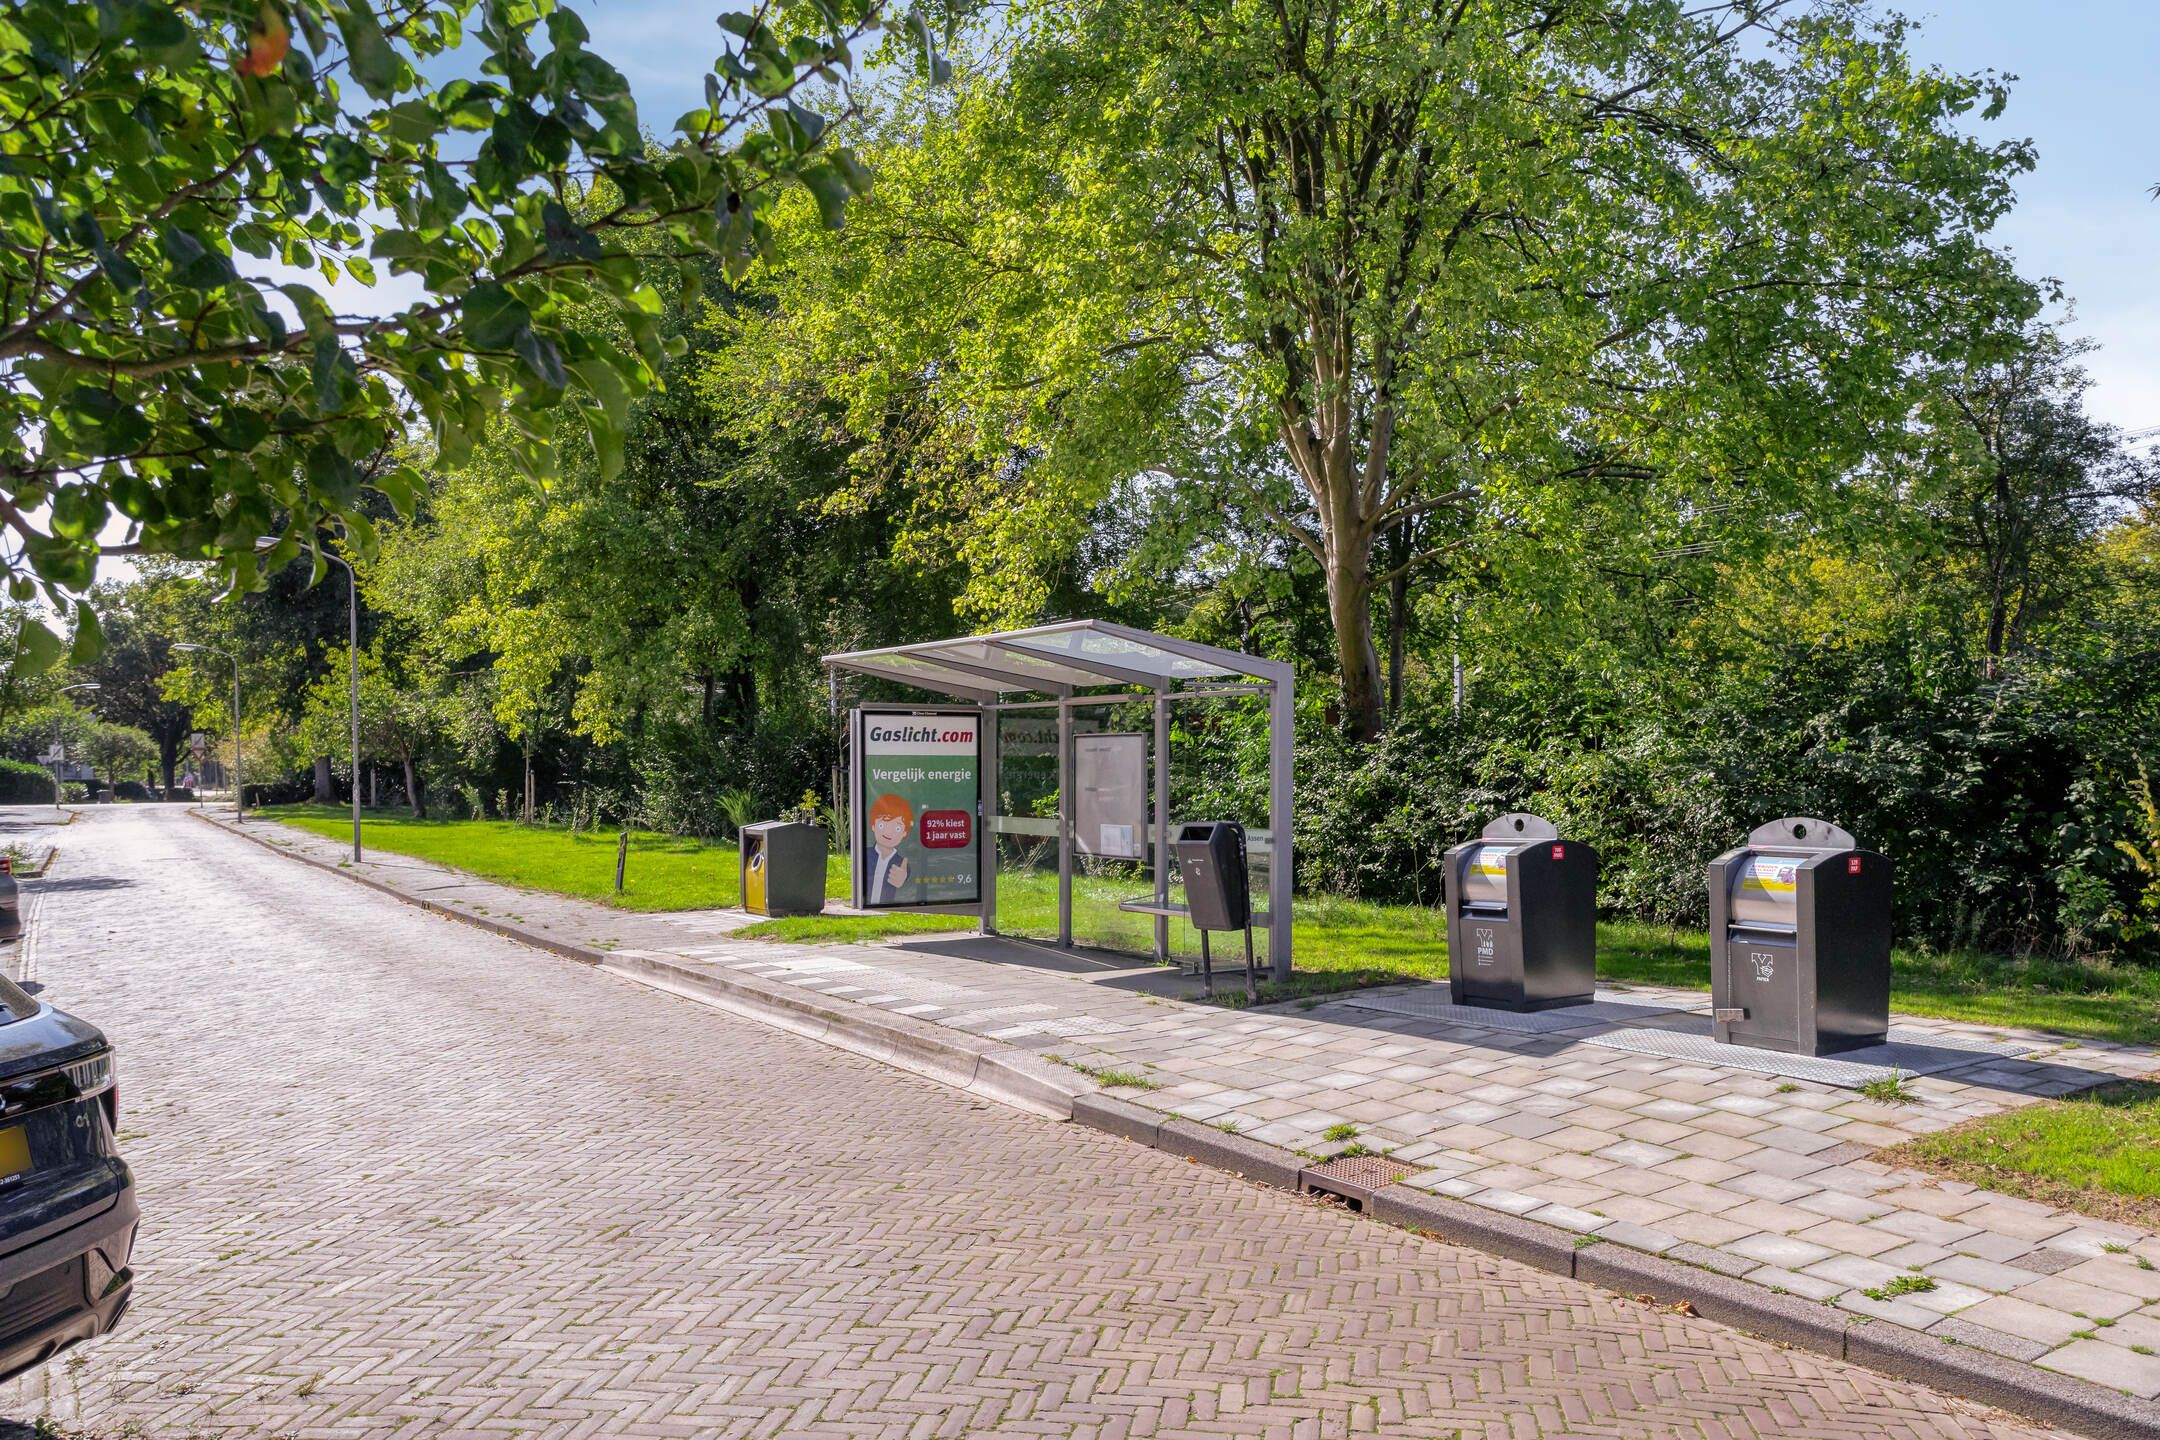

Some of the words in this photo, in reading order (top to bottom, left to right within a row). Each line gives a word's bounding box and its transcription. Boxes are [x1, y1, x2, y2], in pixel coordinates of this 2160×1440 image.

[870, 726, 973, 743] Gaslicht.com
[872, 768, 926, 783] Vergelijk
[928, 768, 972, 781] energie
[926, 819, 945, 828] 92%
[946, 819, 965, 828] kiest
[926, 831, 931, 840] 1
[932, 831, 948, 841] jaar
[950, 831, 966, 839] vast
[957, 874, 972, 885] 9,6
[1478, 947, 1494, 956] PMD
